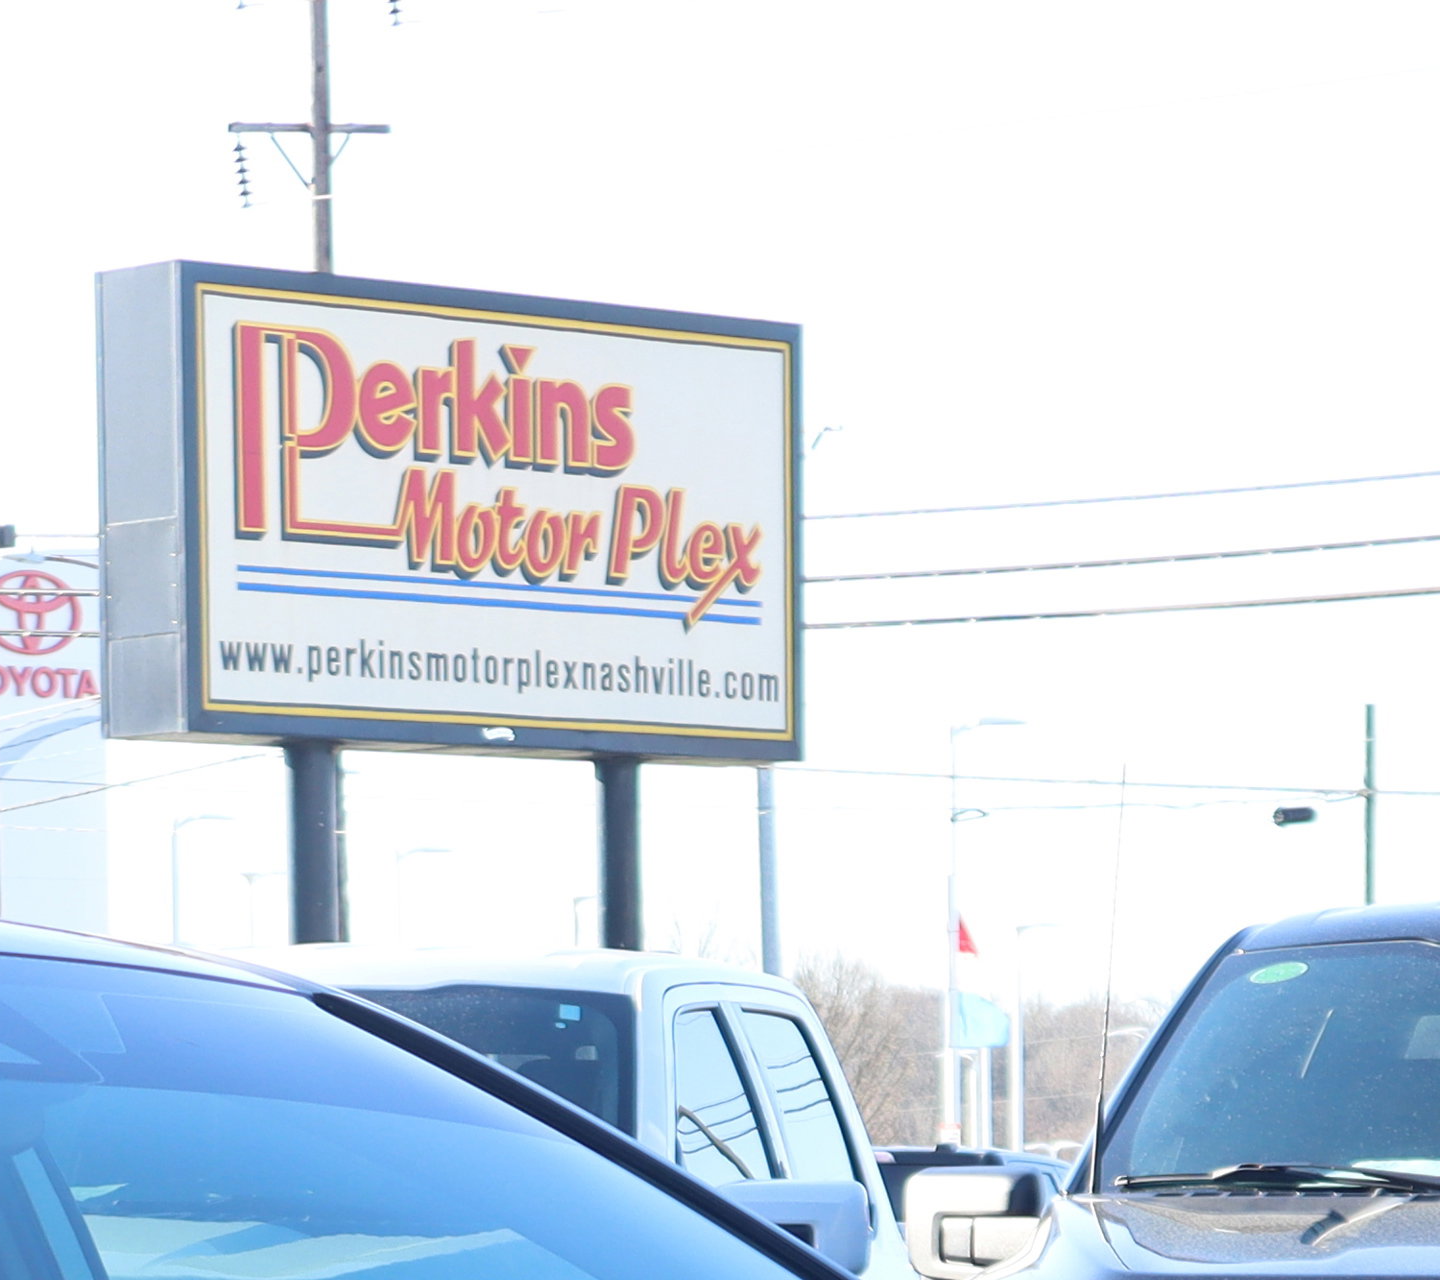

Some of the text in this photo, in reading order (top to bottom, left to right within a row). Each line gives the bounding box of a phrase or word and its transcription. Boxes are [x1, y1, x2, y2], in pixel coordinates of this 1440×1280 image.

[234, 320, 635, 540] Perkins
[400, 466, 763, 630] Motor Plex
[219, 638, 780, 702] www.perkinsmotorplexnashville.com
